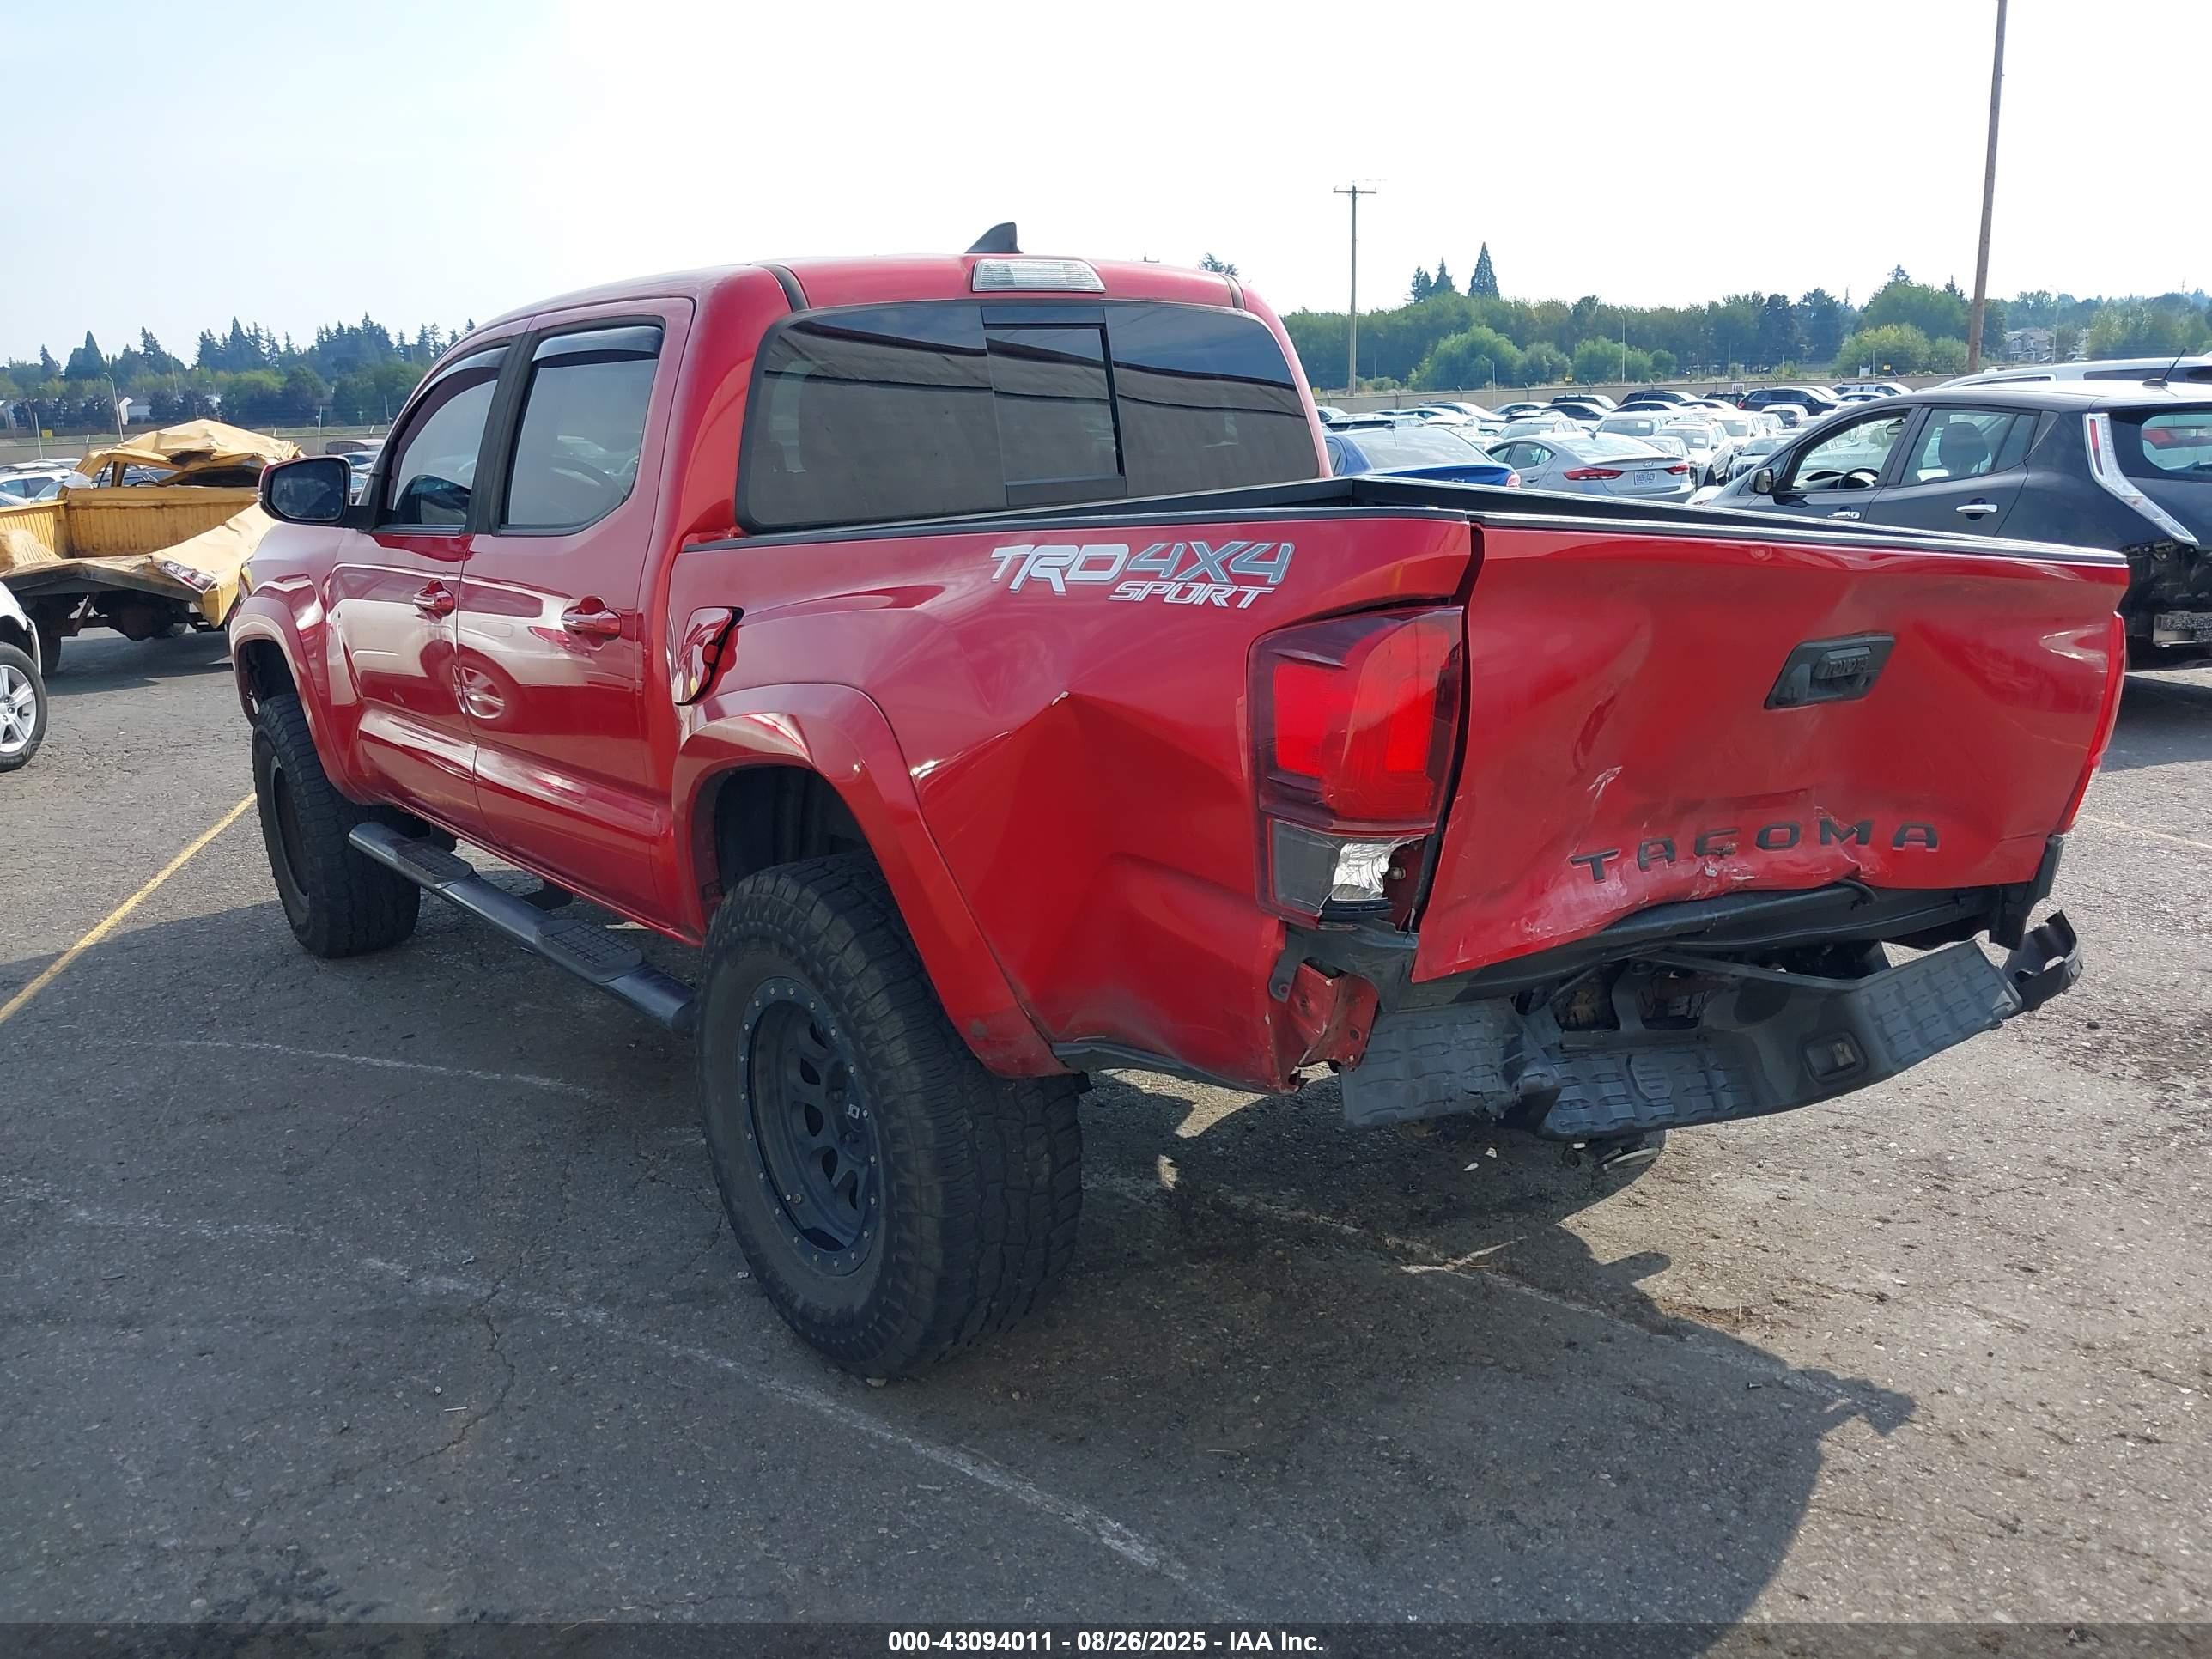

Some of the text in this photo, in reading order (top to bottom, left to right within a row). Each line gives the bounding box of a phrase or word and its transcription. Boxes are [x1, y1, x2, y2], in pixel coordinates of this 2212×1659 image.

[990, 542, 1295, 596] TRD 4X4
[1107, 580, 1276, 610] SPORT
[1570, 817, 1941, 884] TACOMA
